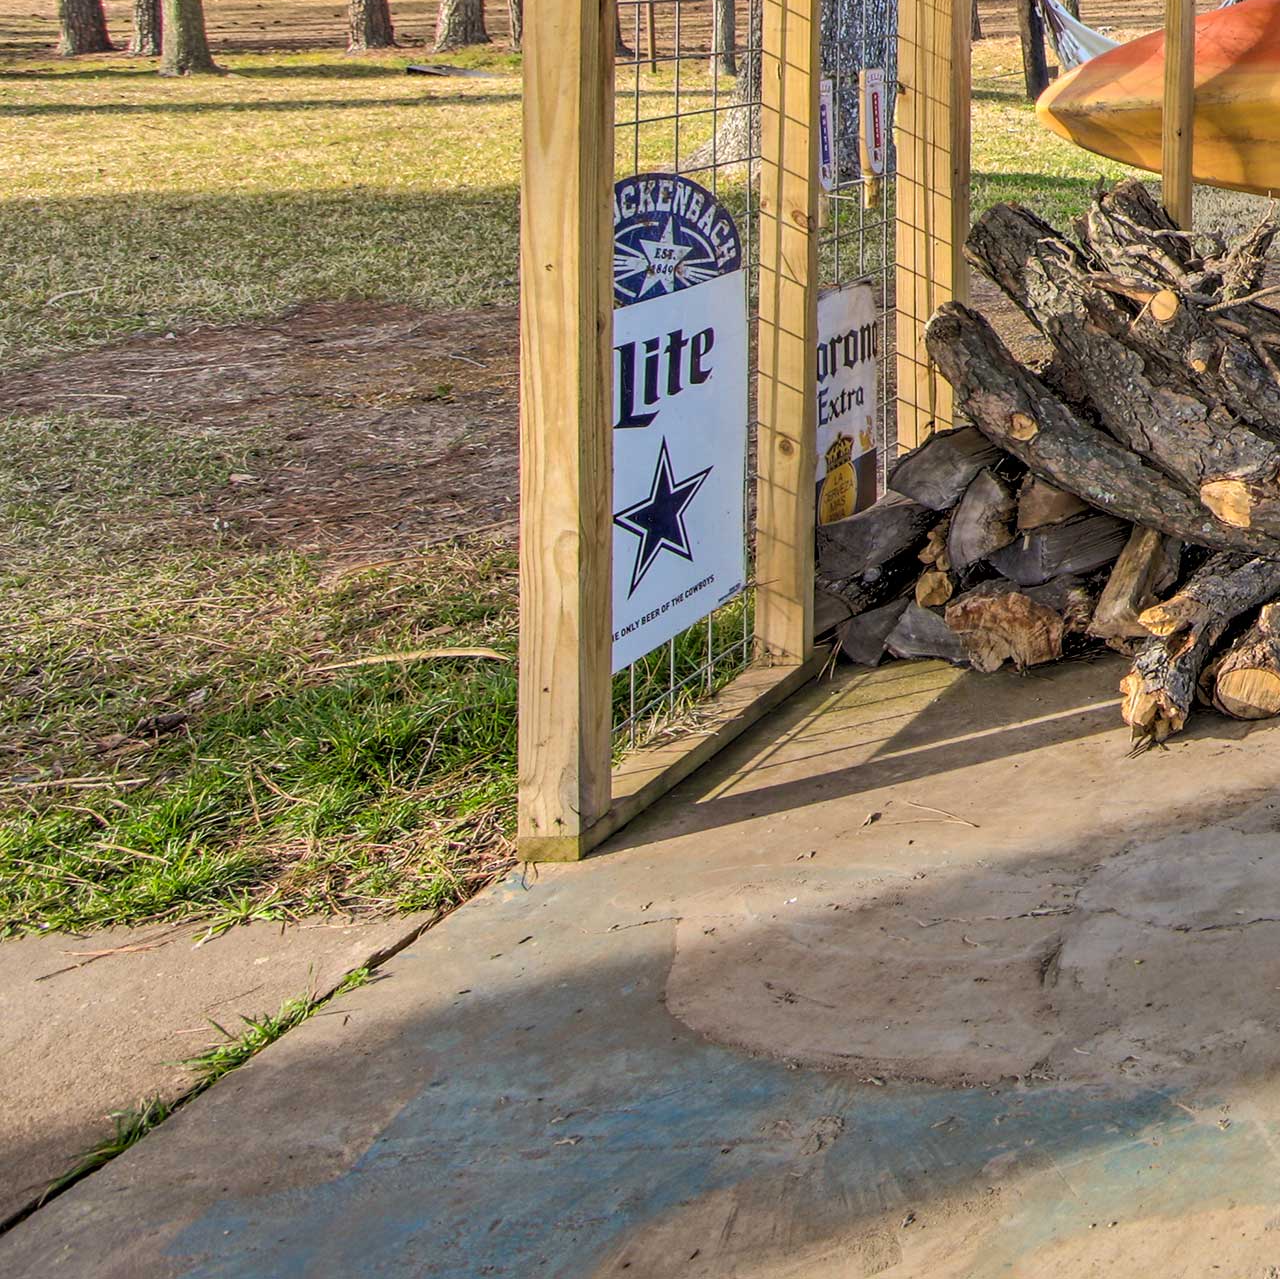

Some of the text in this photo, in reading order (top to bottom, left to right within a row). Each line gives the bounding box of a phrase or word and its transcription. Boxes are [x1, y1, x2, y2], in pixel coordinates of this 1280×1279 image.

[654, 247, 677, 260] EST.
[613, 326, 715, 429] Lite
[817, 385, 864, 428] Extra
[620, 619, 641, 637] ONLY
[641, 607, 661, 625] BEER
[661, 602, 671, 614] OF
[671, 593, 684, 608] THE
[684, 574, 716, 599] COWBOYS
